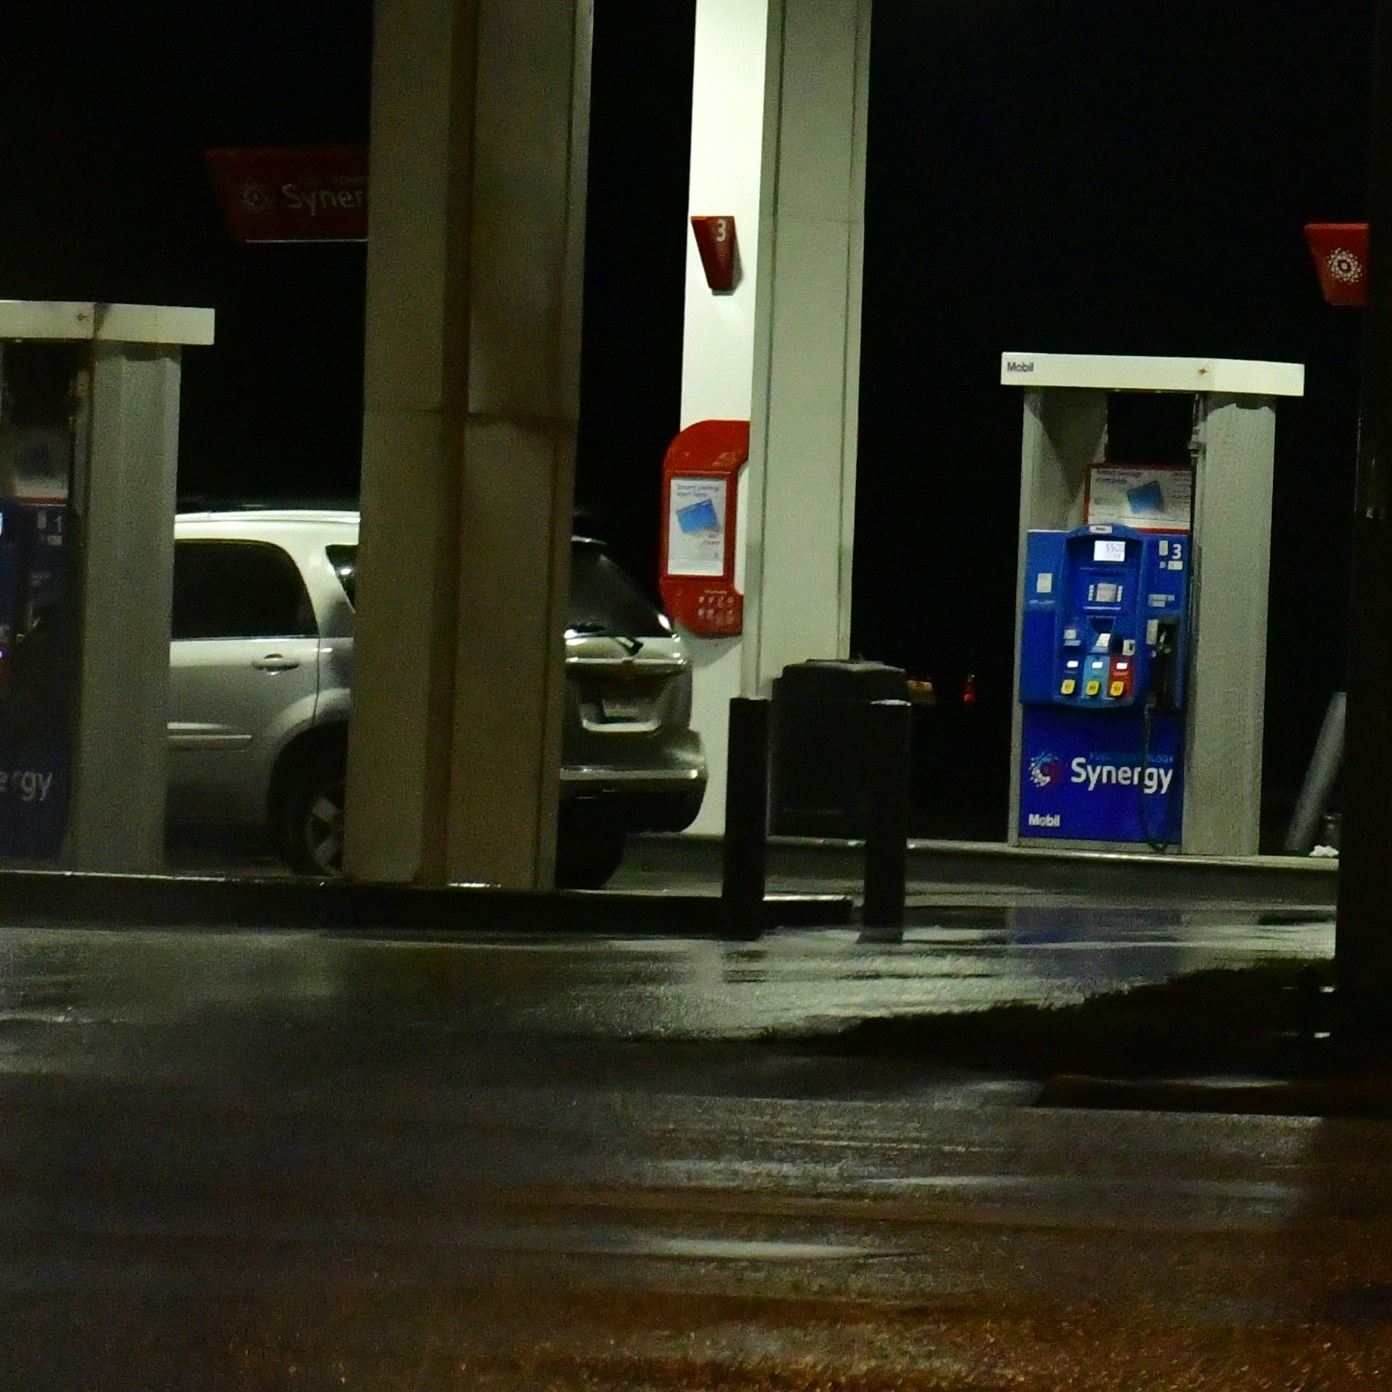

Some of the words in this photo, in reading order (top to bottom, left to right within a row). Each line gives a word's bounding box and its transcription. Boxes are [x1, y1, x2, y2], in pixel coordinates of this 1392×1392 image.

[280, 183, 365, 217] Syner
[716, 218, 727, 242] 3
[1006, 361, 1034, 373] Mobil
[1171, 543, 1182, 560] 3
[0, 771, 53, 801] ergy
[1070, 756, 1174, 795] Synergy
[1028, 812, 1061, 828] Mobil
